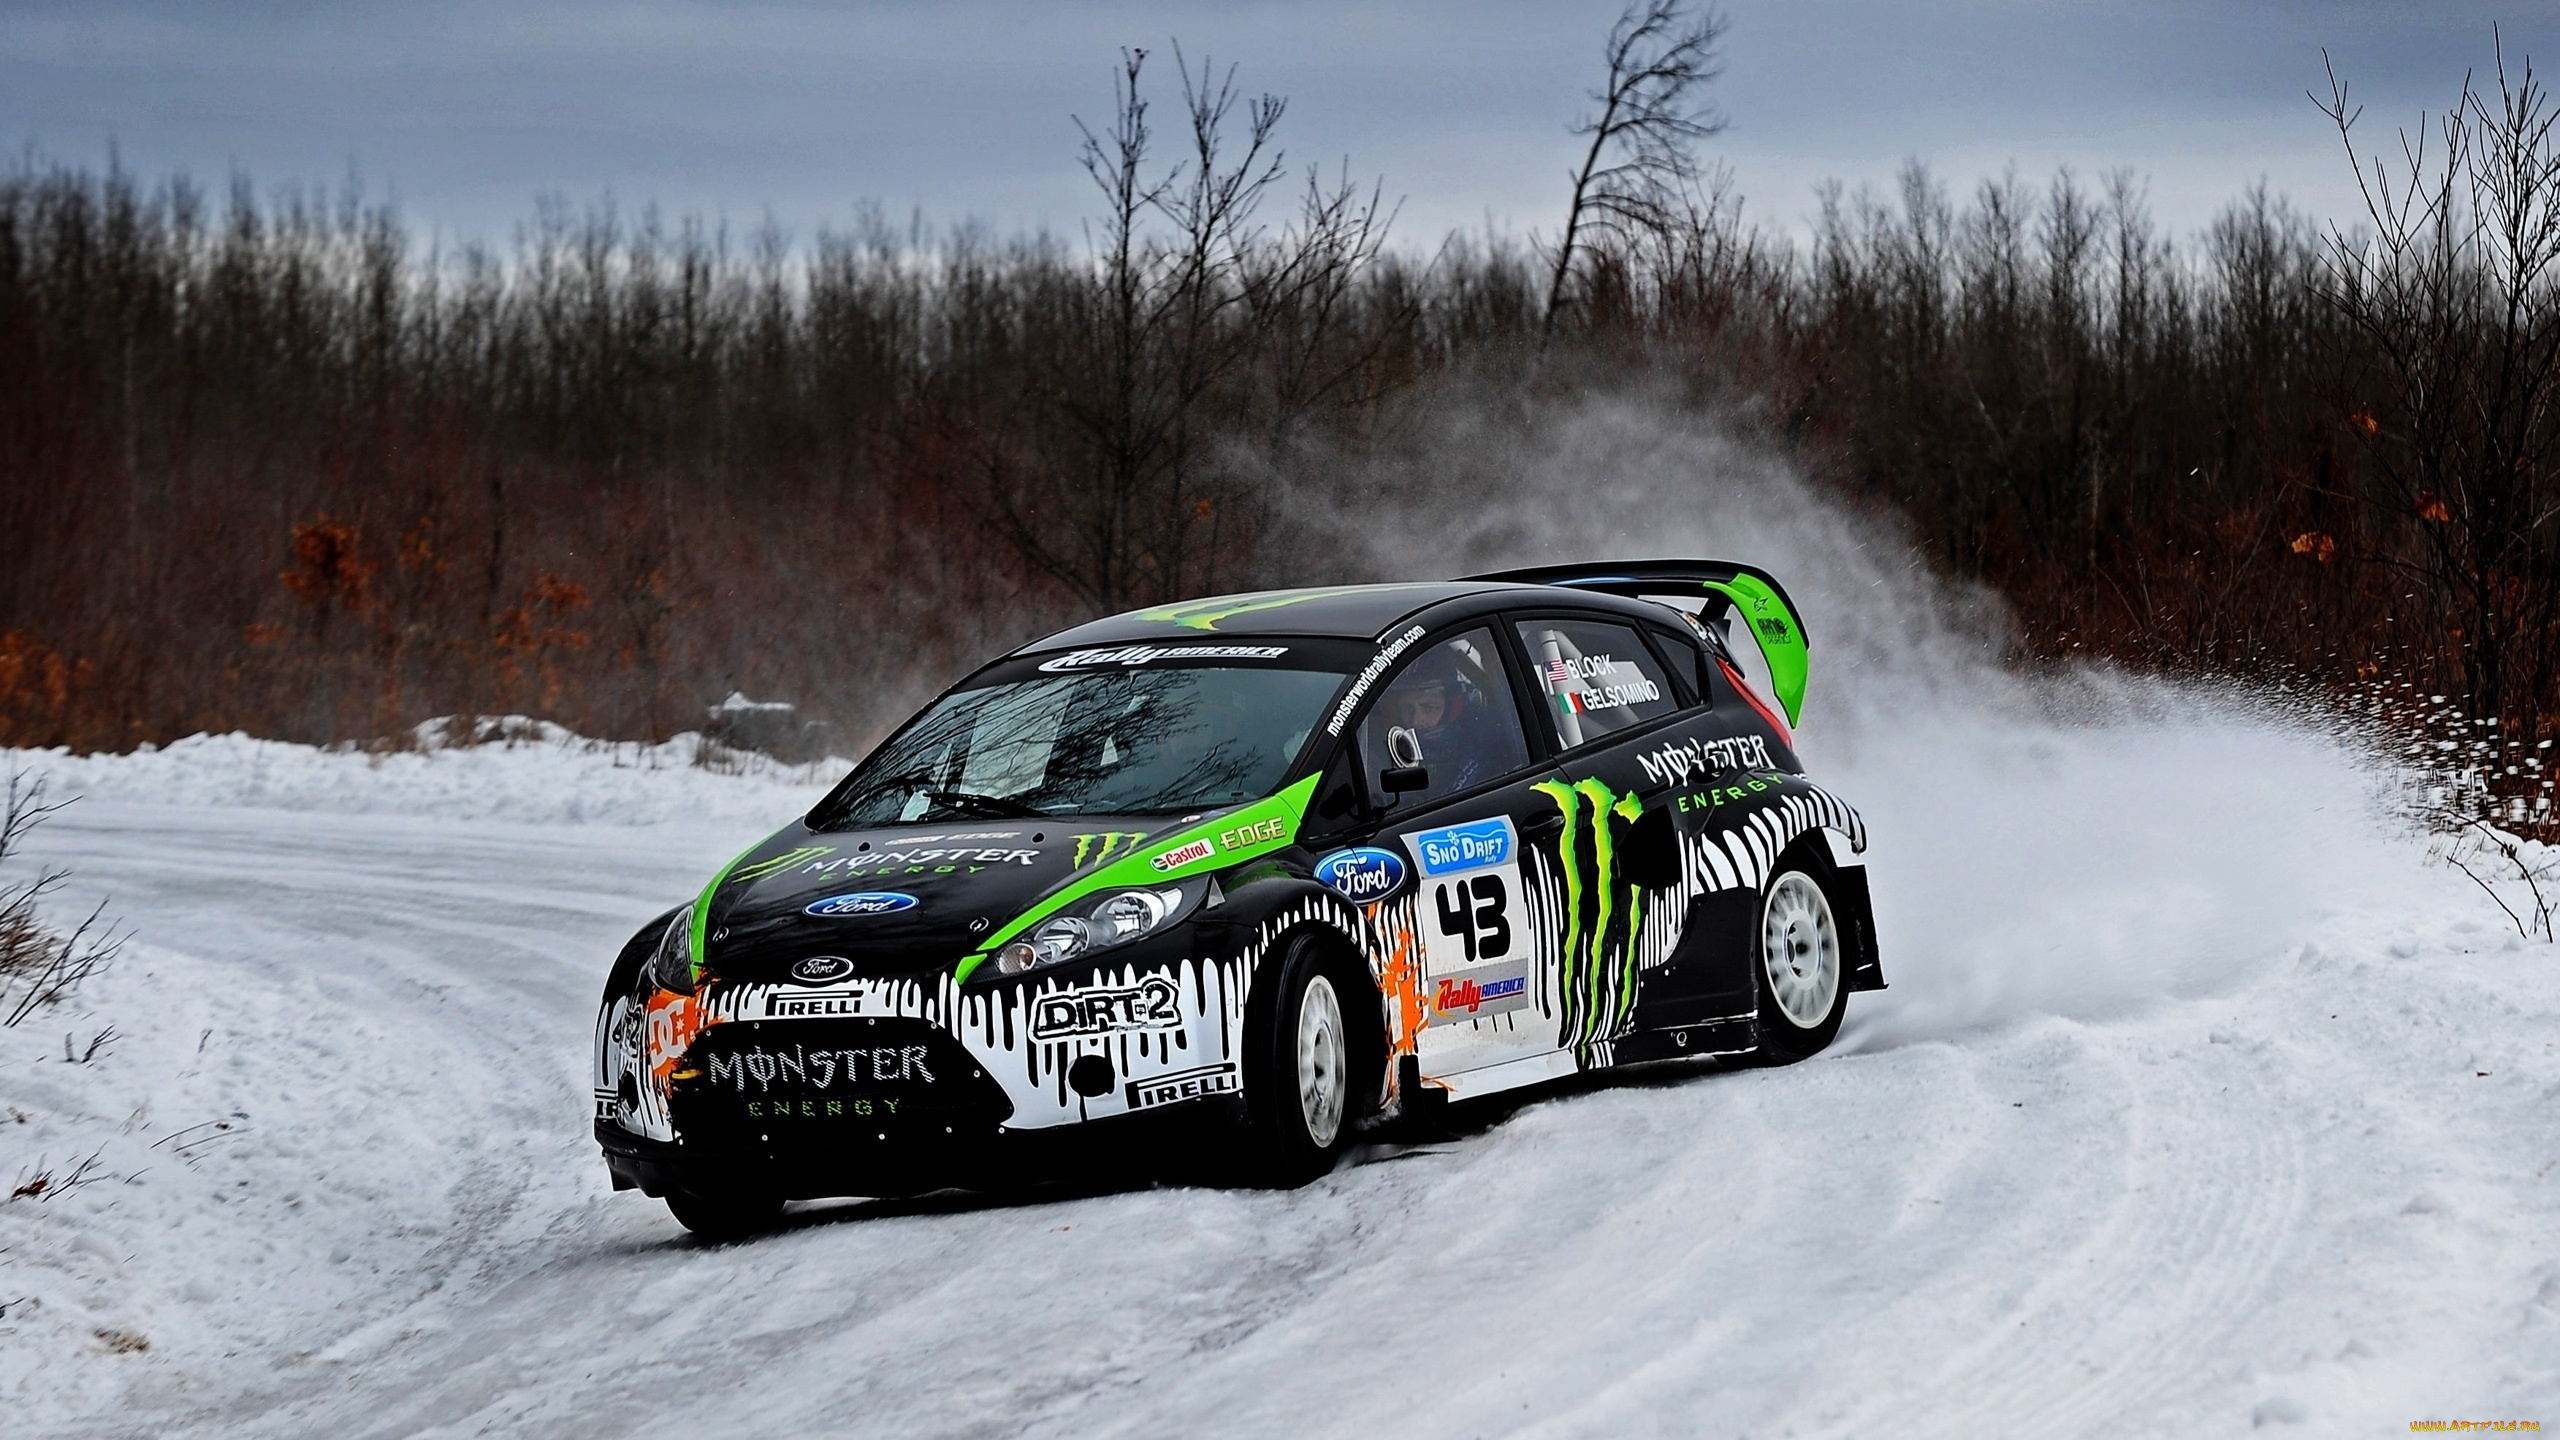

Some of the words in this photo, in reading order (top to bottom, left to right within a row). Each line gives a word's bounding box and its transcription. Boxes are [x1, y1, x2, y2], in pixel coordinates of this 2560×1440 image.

[1327, 625, 1426, 737] monsterworldrallyteam.com
[1565, 654, 1617, 679] BLOCK
[1581, 680, 1660, 711] GELSOMINO
[1677, 775, 1783, 813] ENERGY
[1165, 842, 1209, 866] Castrol
[1219, 816, 1286, 852] EDGE
[801, 848, 1040, 875] MONSTER
[818, 865, 986, 882] ENERGY
[1332, 856, 1390, 897] Ford
[822, 895, 898, 914] Ford
[1435, 874, 1511, 962] 43
[803, 959, 838, 975] Ford
[765, 990, 864, 1016] PIRELLI
[1145, 984, 1175, 1020] 2
[1438, 978, 1482, 1013] Rally
[1481, 977, 1525, 998] AMERICA
[708, 1044, 935, 1092] MONSTER
[1125, 1063, 1237, 1110] PIRELLI
[749, 1098, 900, 1117] ENERGY
